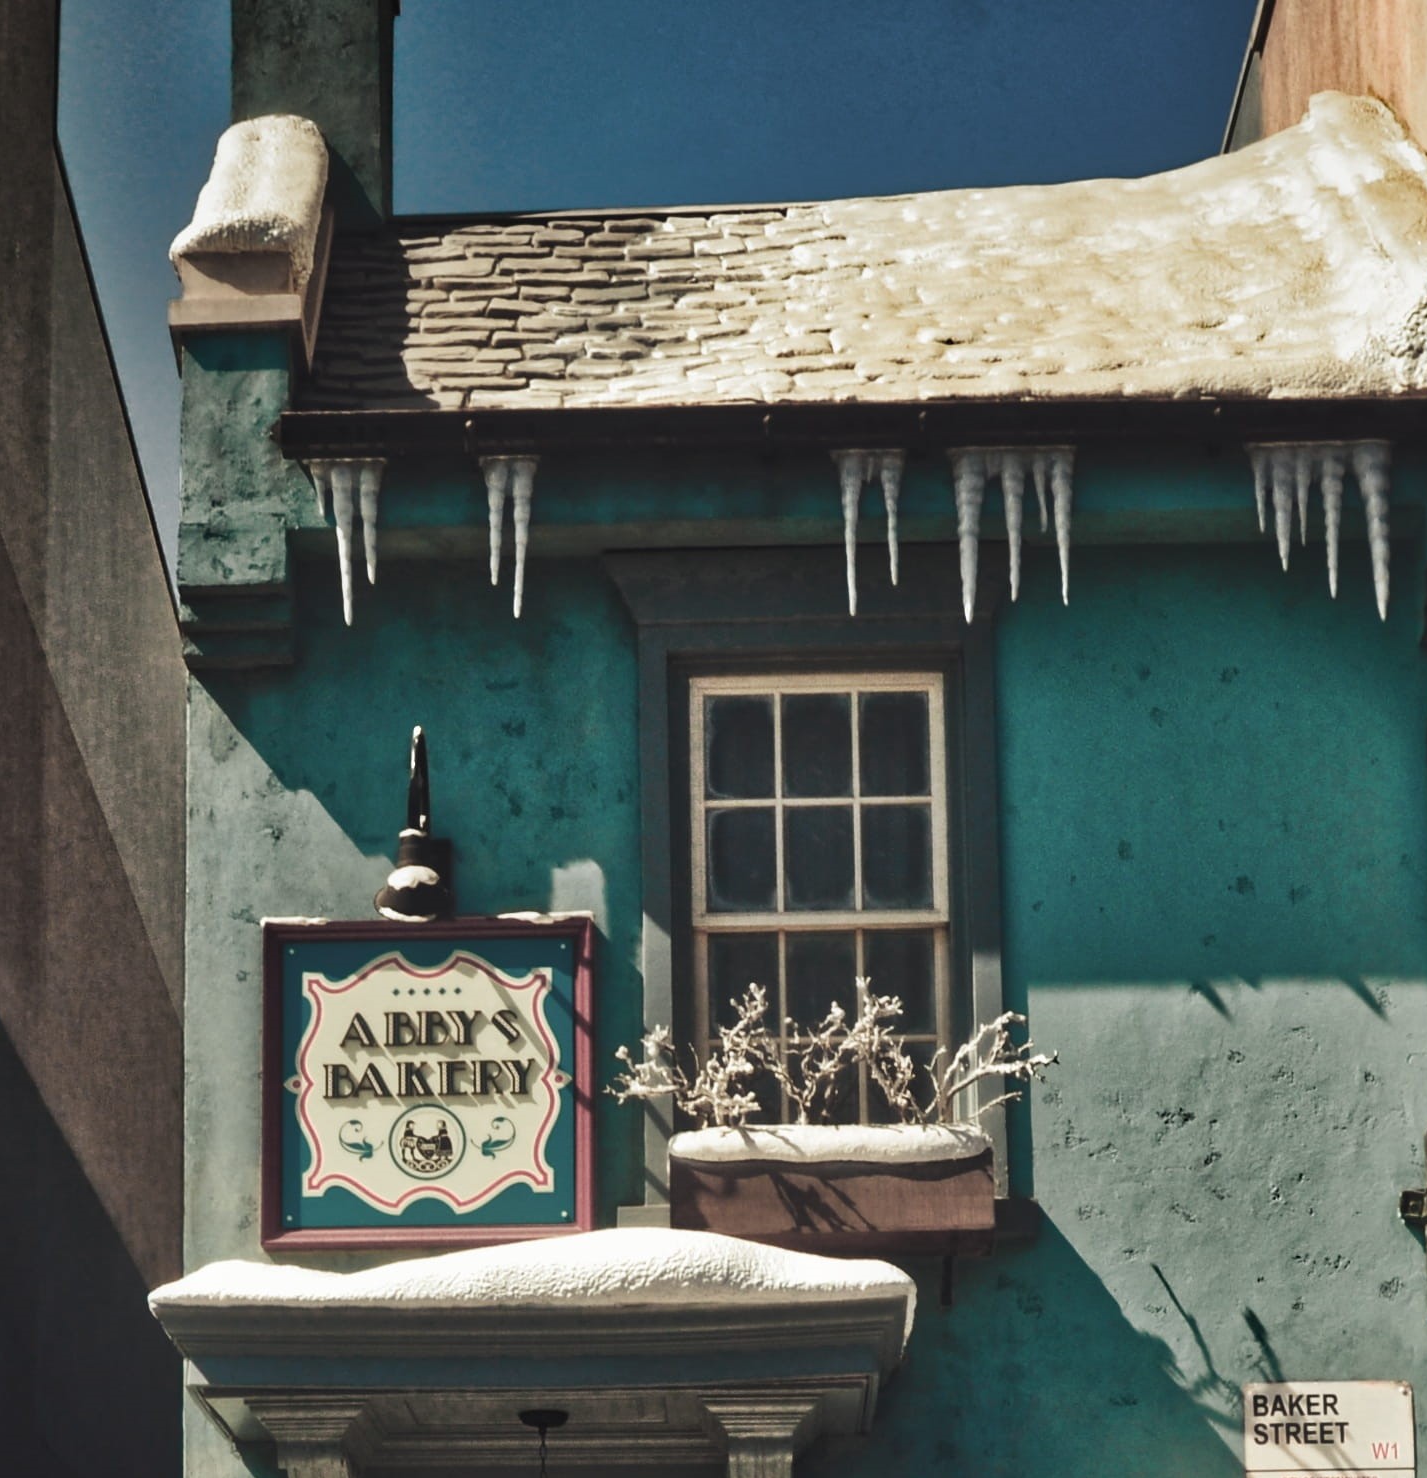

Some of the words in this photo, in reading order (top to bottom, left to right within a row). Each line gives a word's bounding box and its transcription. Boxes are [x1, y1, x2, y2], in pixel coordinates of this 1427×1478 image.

[323, 1058, 536, 1099] BAKERY
[1253, 1394, 1339, 1417] BAKER
[1253, 1422, 1349, 1445] STREET
[1372, 1442, 1399, 1460] W1
